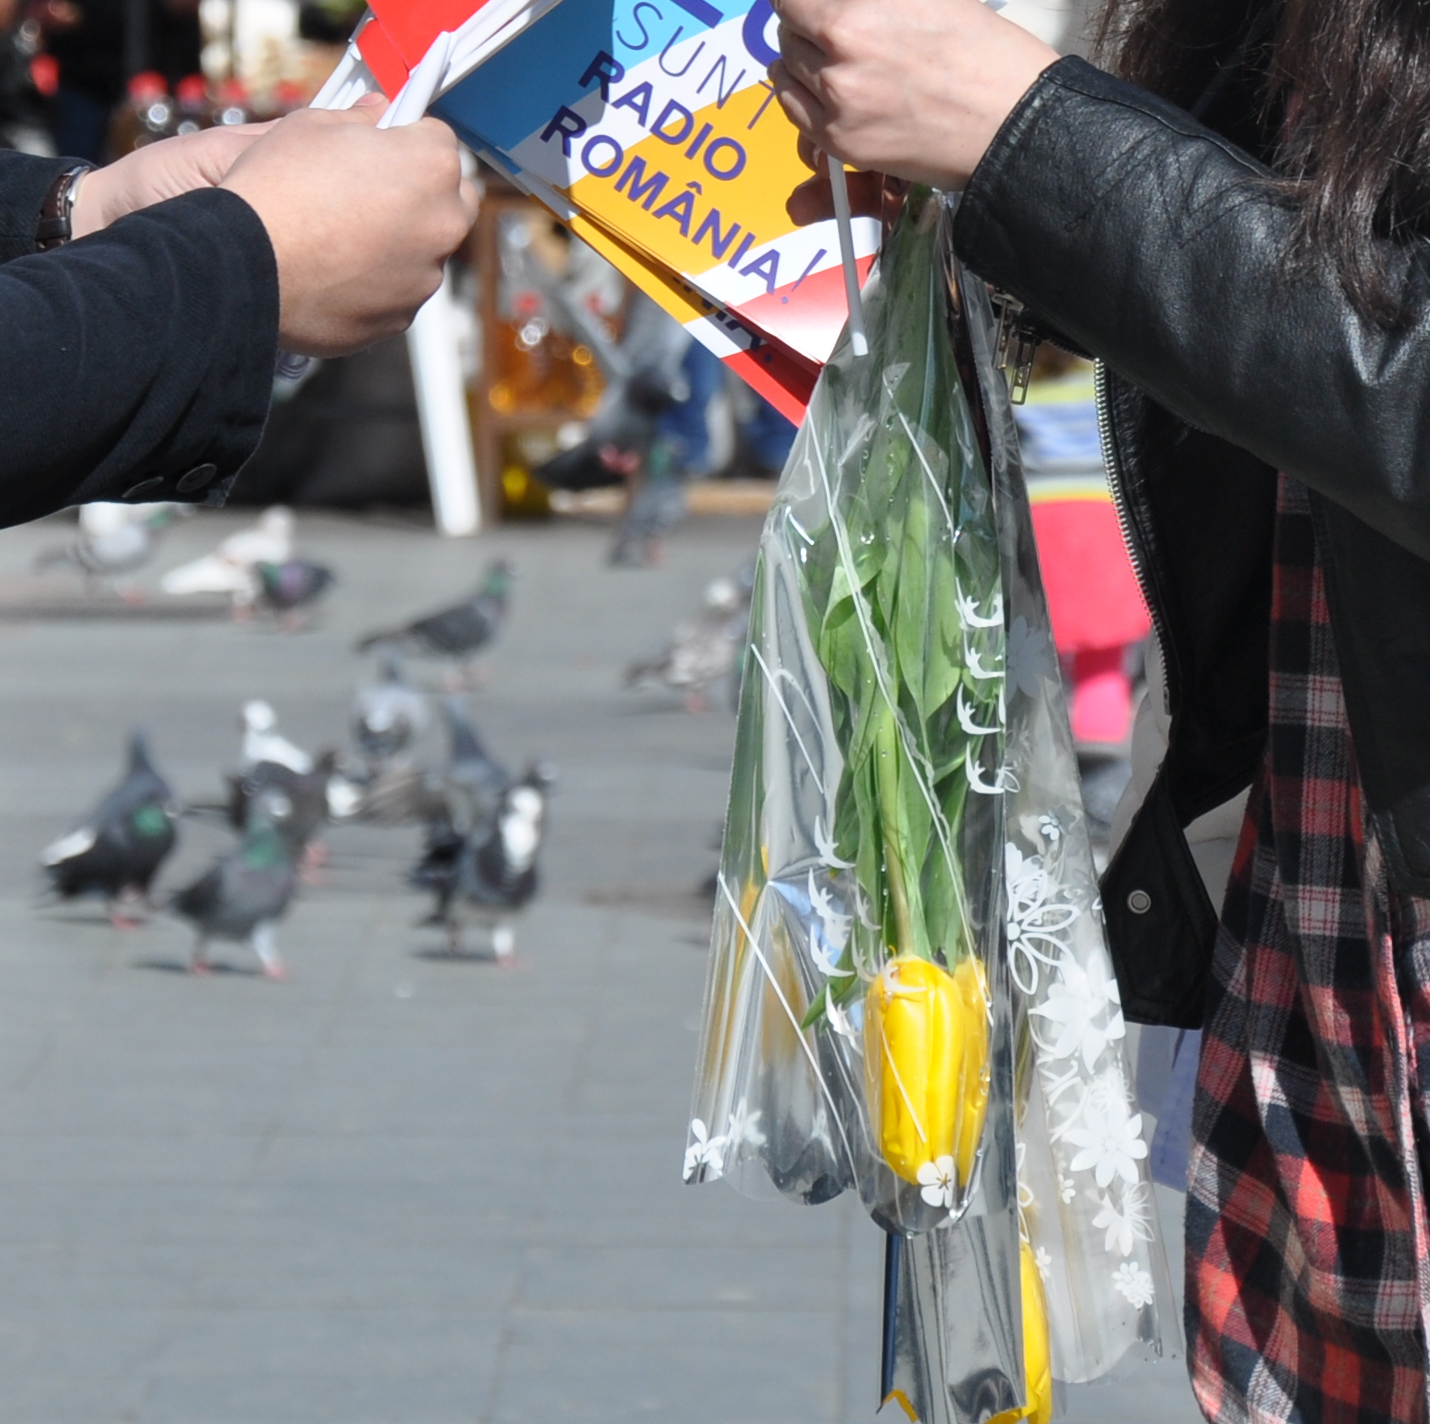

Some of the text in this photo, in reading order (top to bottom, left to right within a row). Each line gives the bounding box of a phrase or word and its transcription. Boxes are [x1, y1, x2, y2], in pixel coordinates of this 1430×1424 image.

[578, 50, 747, 181] RADIO
[616, 1, 776, 130] SUNT
[539, 105, 827, 304] ROMÂNIA!
